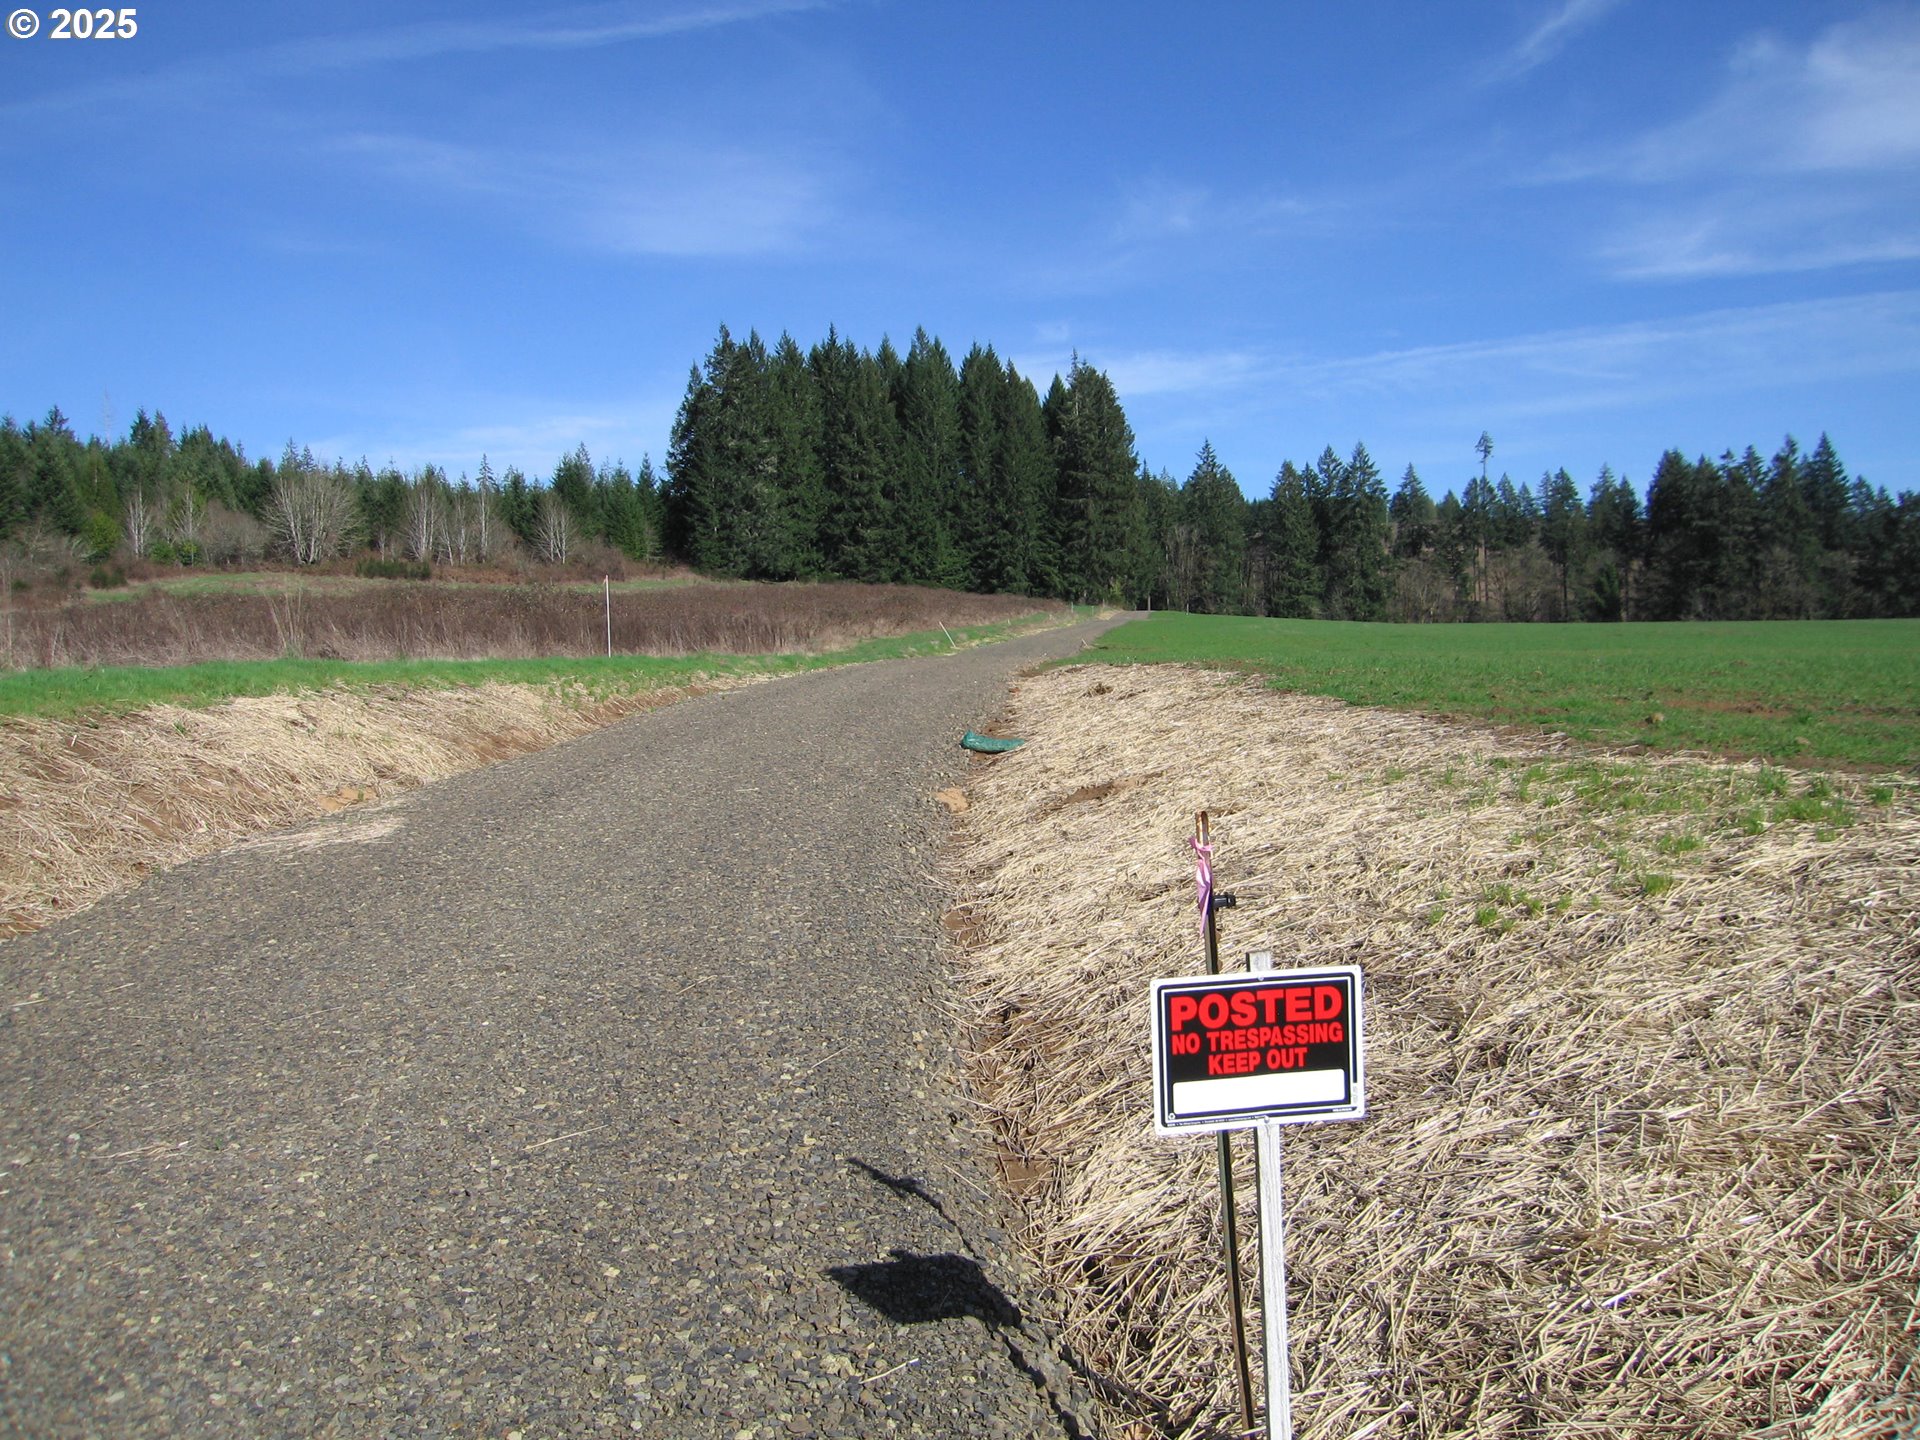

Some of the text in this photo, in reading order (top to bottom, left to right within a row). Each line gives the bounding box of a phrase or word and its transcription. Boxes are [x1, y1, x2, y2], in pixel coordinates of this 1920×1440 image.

[1170, 985, 1343, 1032] POSTED
[1171, 1021, 1344, 1055] NO TRESPASSING
[1208, 1047, 1308, 1076] KEEP OUT
